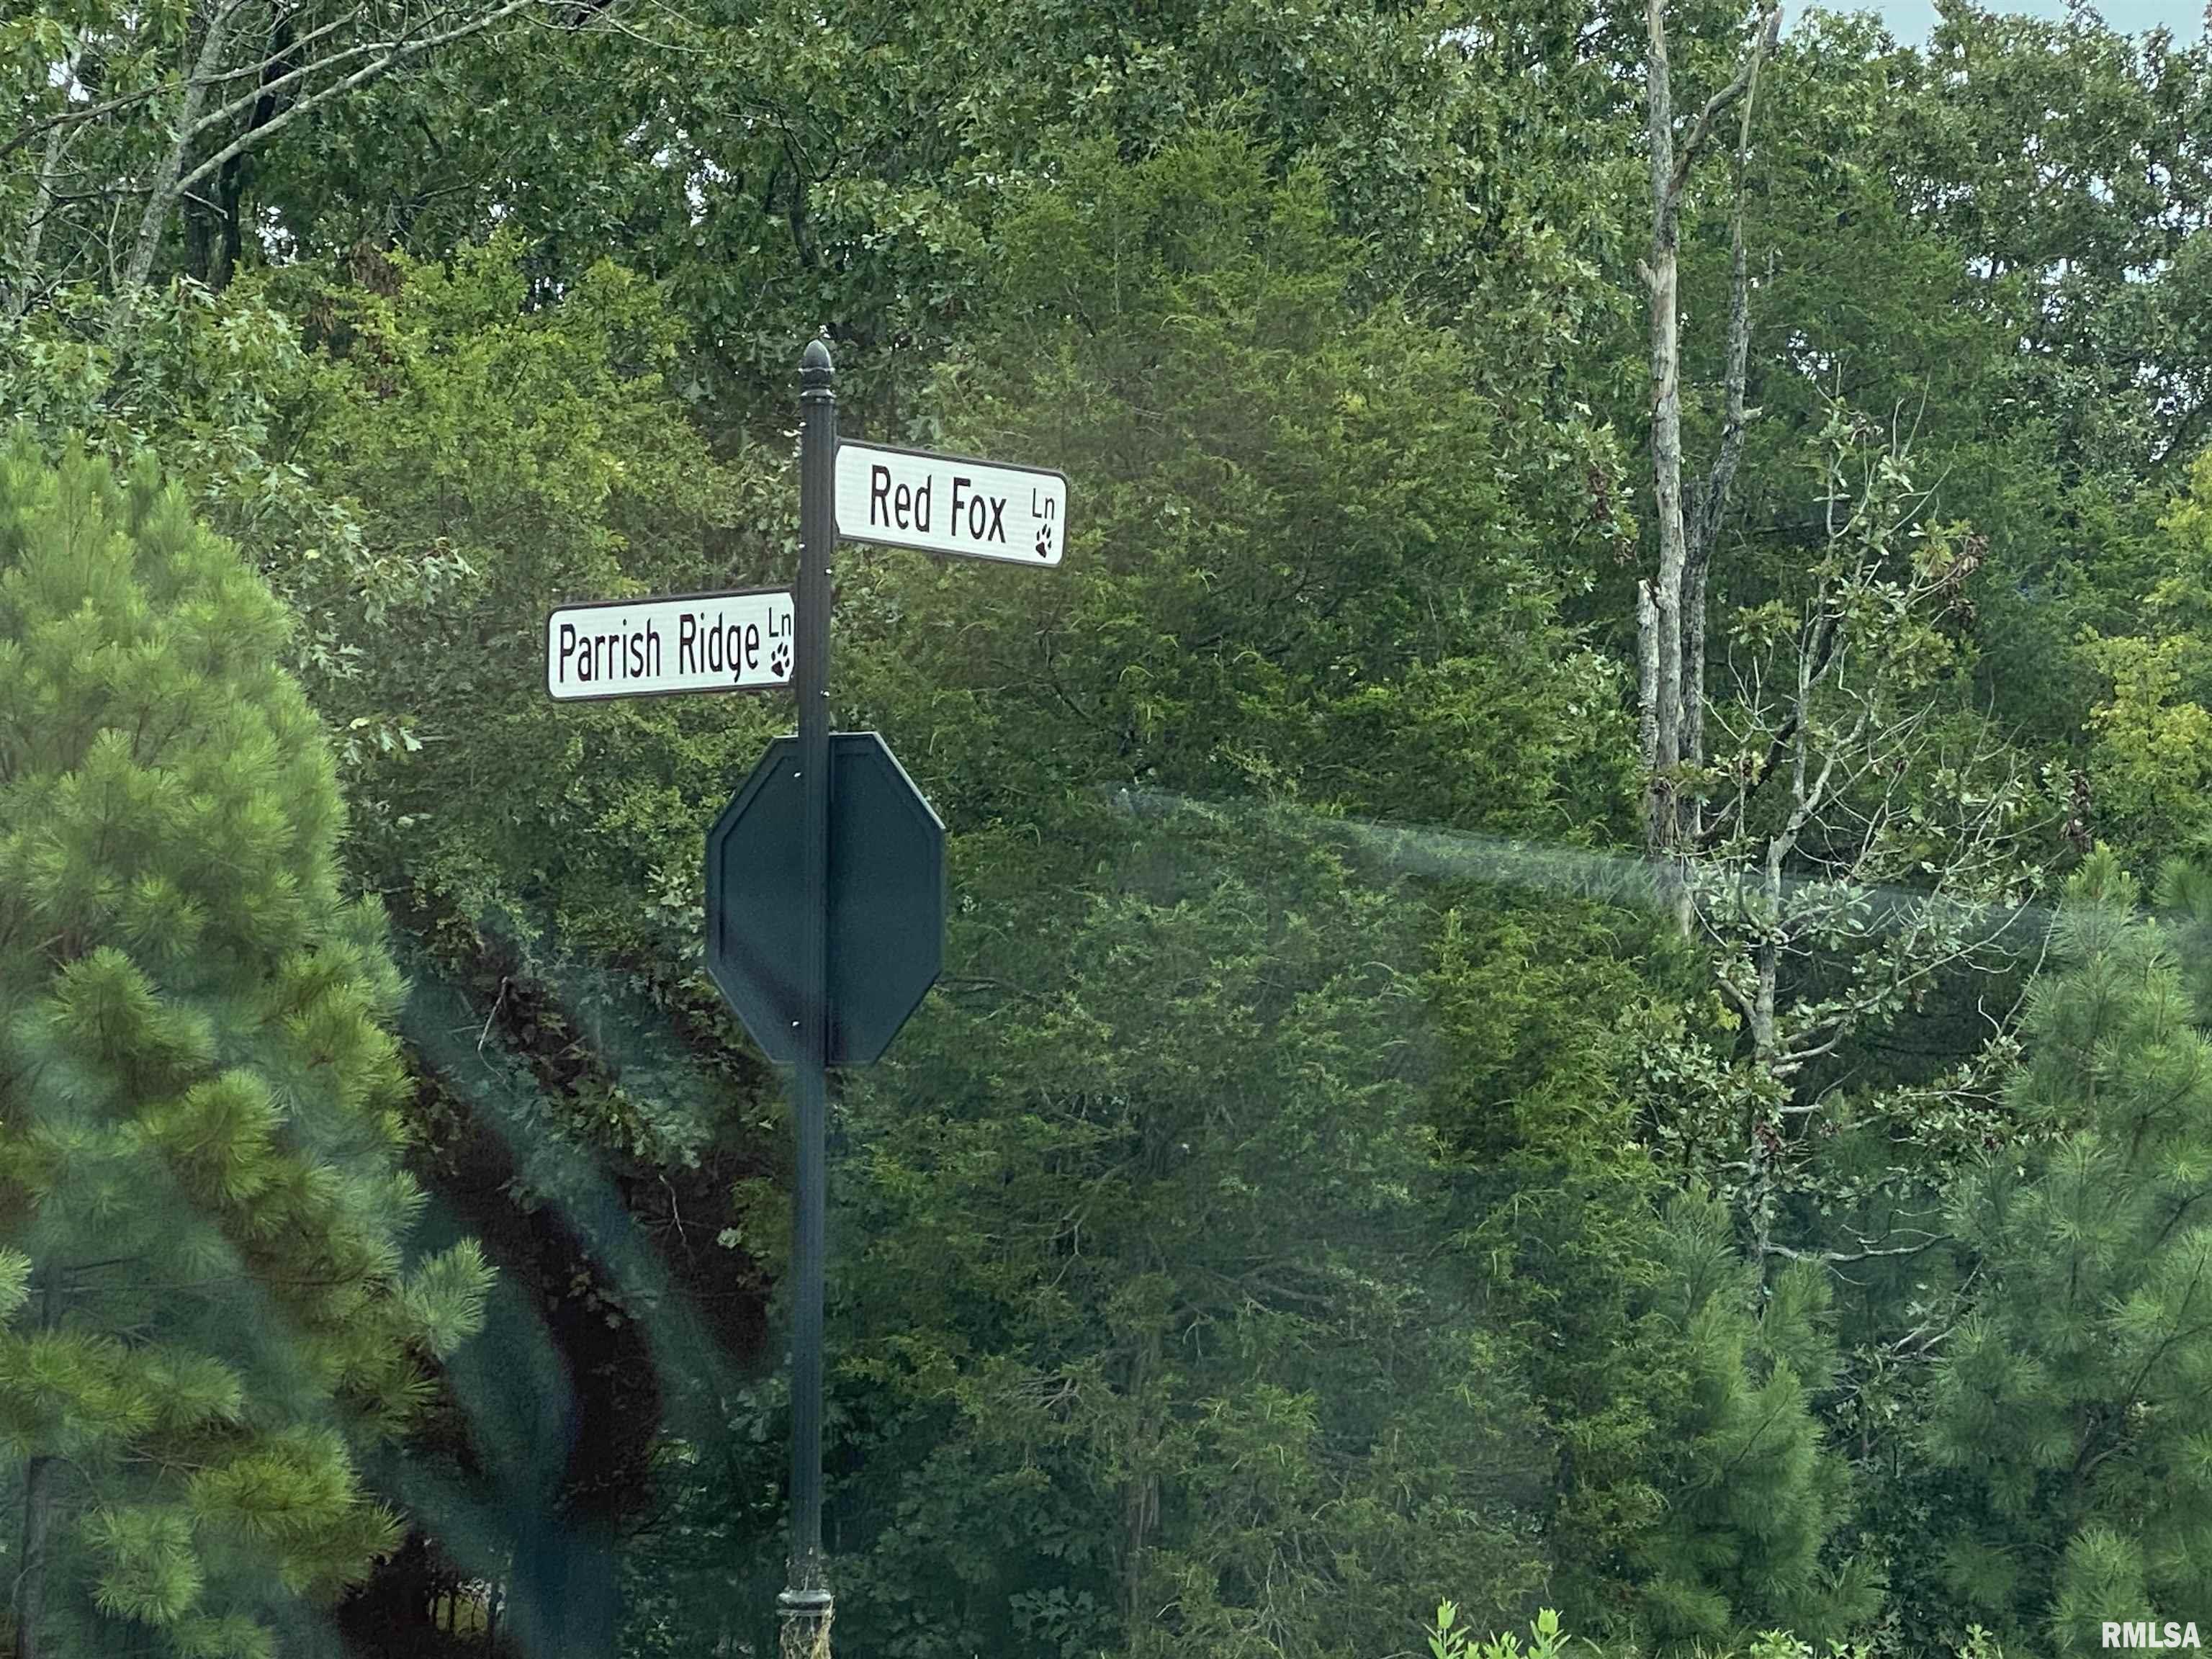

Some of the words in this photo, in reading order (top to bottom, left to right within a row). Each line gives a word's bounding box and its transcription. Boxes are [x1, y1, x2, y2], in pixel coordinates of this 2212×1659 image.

[871, 464, 932, 532] Red
[951, 477, 1007, 543] Fox
[1032, 487, 1055, 520] Ln
[559, 618, 660, 683] Parrish
[679, 612, 759, 683] Ridge
[768, 607, 791, 637] Ln
